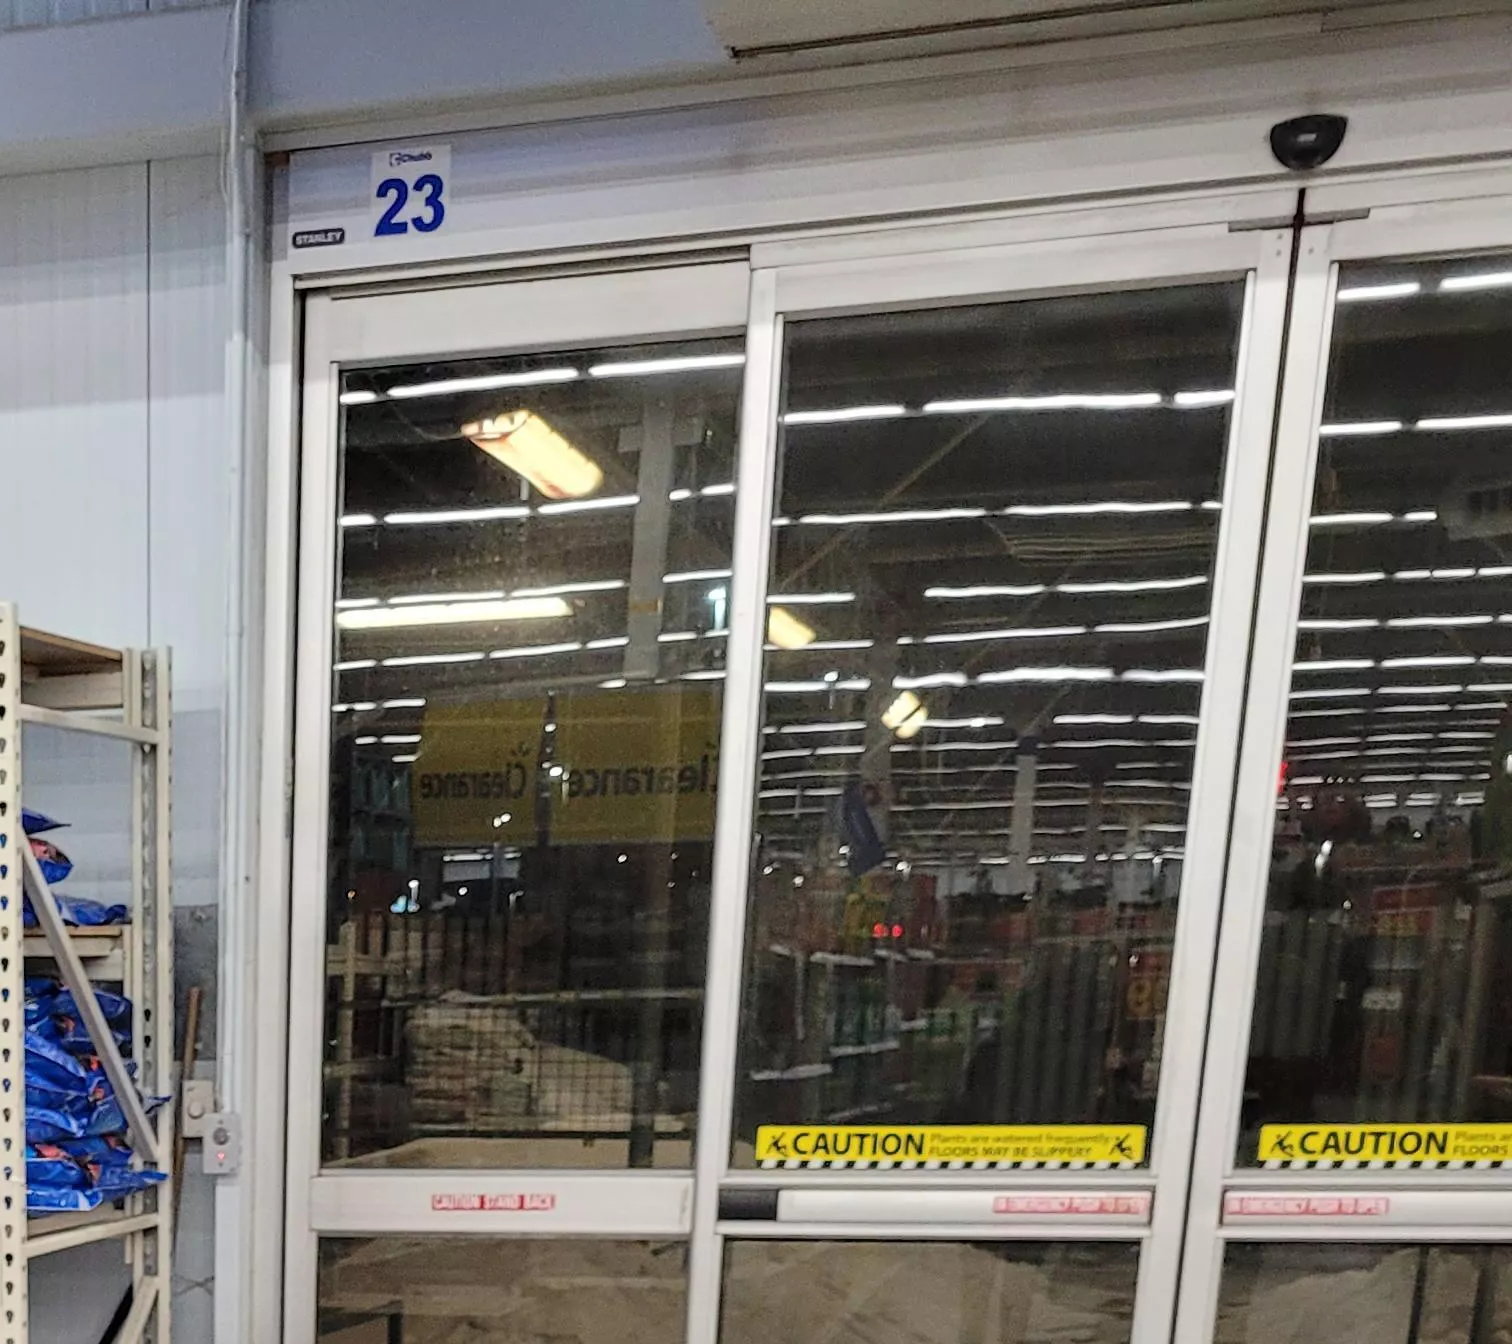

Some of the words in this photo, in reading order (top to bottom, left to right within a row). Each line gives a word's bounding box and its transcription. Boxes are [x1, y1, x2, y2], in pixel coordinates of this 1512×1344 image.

[374, 174, 445, 237] 23
[295, 230, 344, 246] STANLEY
[929, 1133, 966, 1143] Plants
[970, 1135, 990, 1143] are
[993, 1133, 1043, 1143] watered
[1046, 1133, 1111, 1145] frequently
[1299, 1130, 1449, 1155] CAUTION
[1455, 1131, 1496, 1142] Plants
[793, 1132, 925, 1156] CAUTION
[1453, 1145, 1509, 1157] FLOORS
[929, 1146, 978, 1157] FLOORS
[982, 1146, 1008, 1157] MAY
[1013, 1146, 1028, 1157] BE
[1031, 1146, 1093, 1157] SLIPPERY
